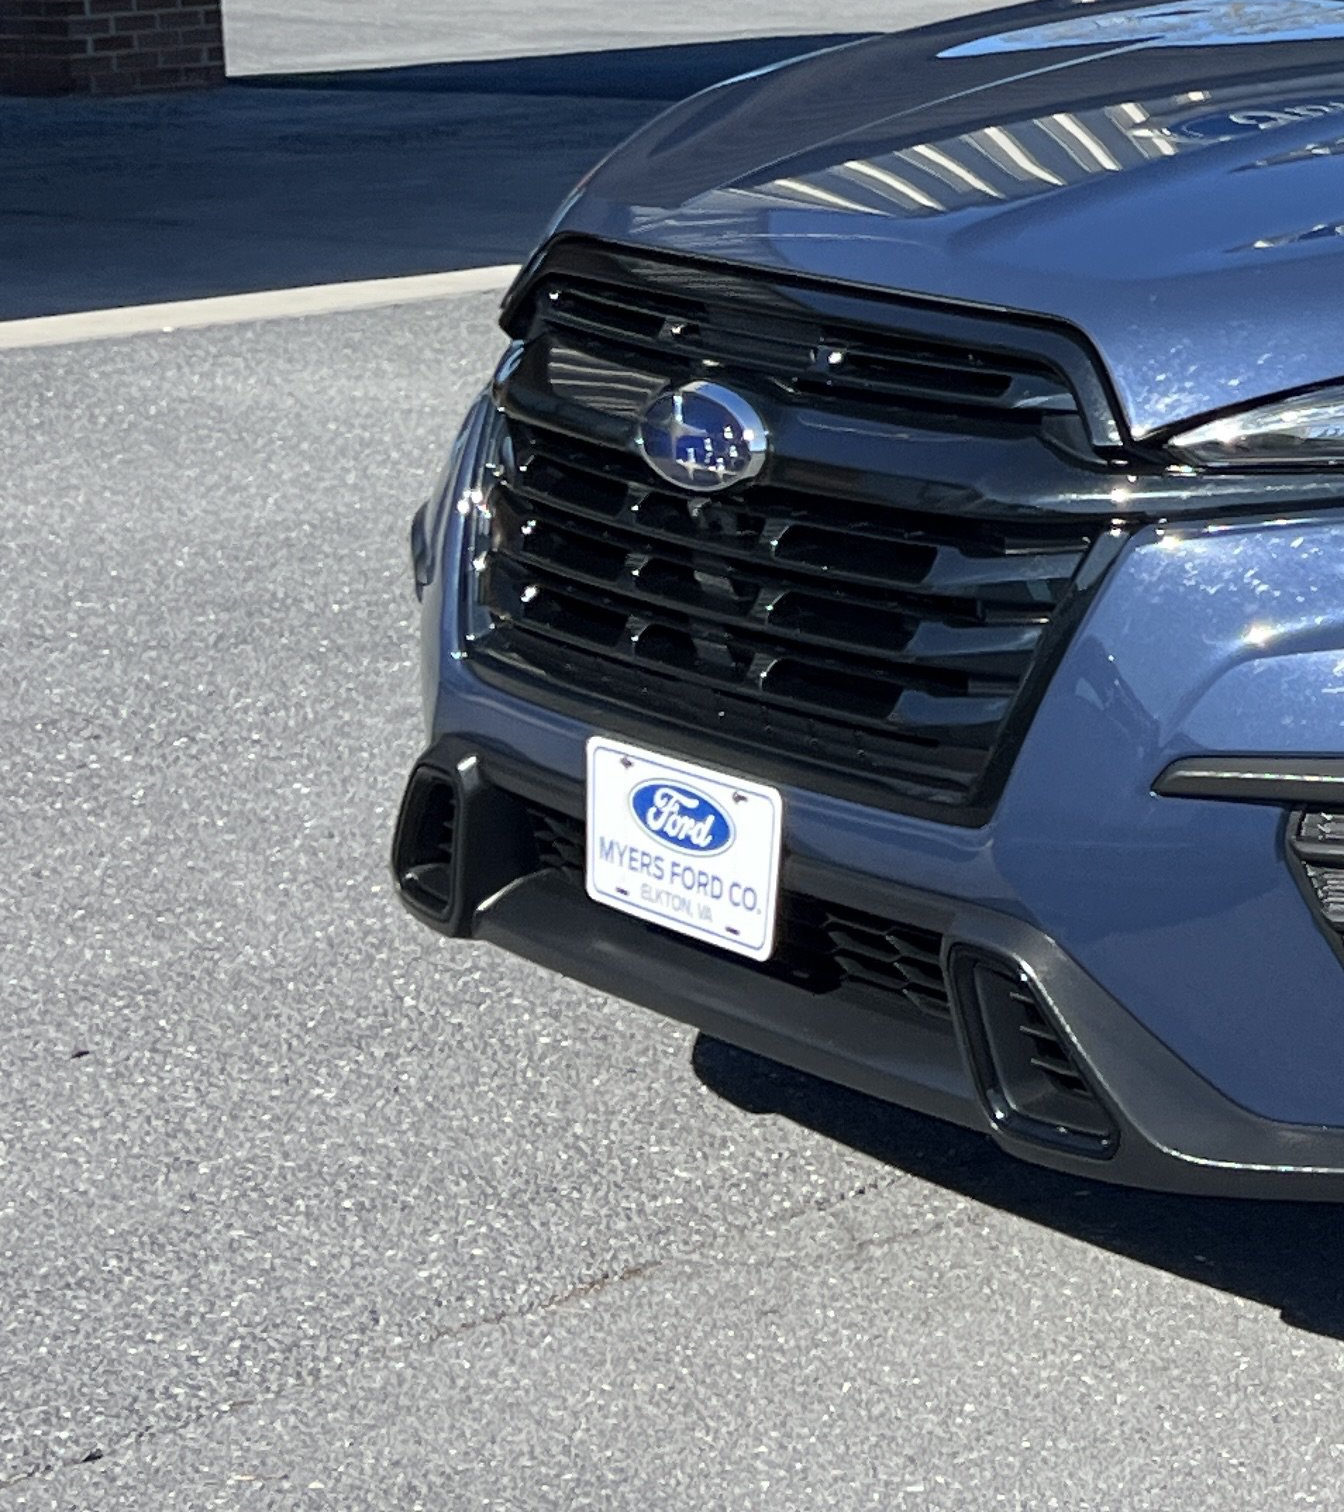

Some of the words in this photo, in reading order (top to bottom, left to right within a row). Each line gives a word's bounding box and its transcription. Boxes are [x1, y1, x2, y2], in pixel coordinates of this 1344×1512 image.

[646, 786, 715, 848] Ford
[599, 836, 665, 881] MYERS
[669, 860, 724, 900] FORD
[729, 882, 762, 915] CO.
[640, 883, 694, 919] ELKTON,
[696, 903, 714, 923] VA
